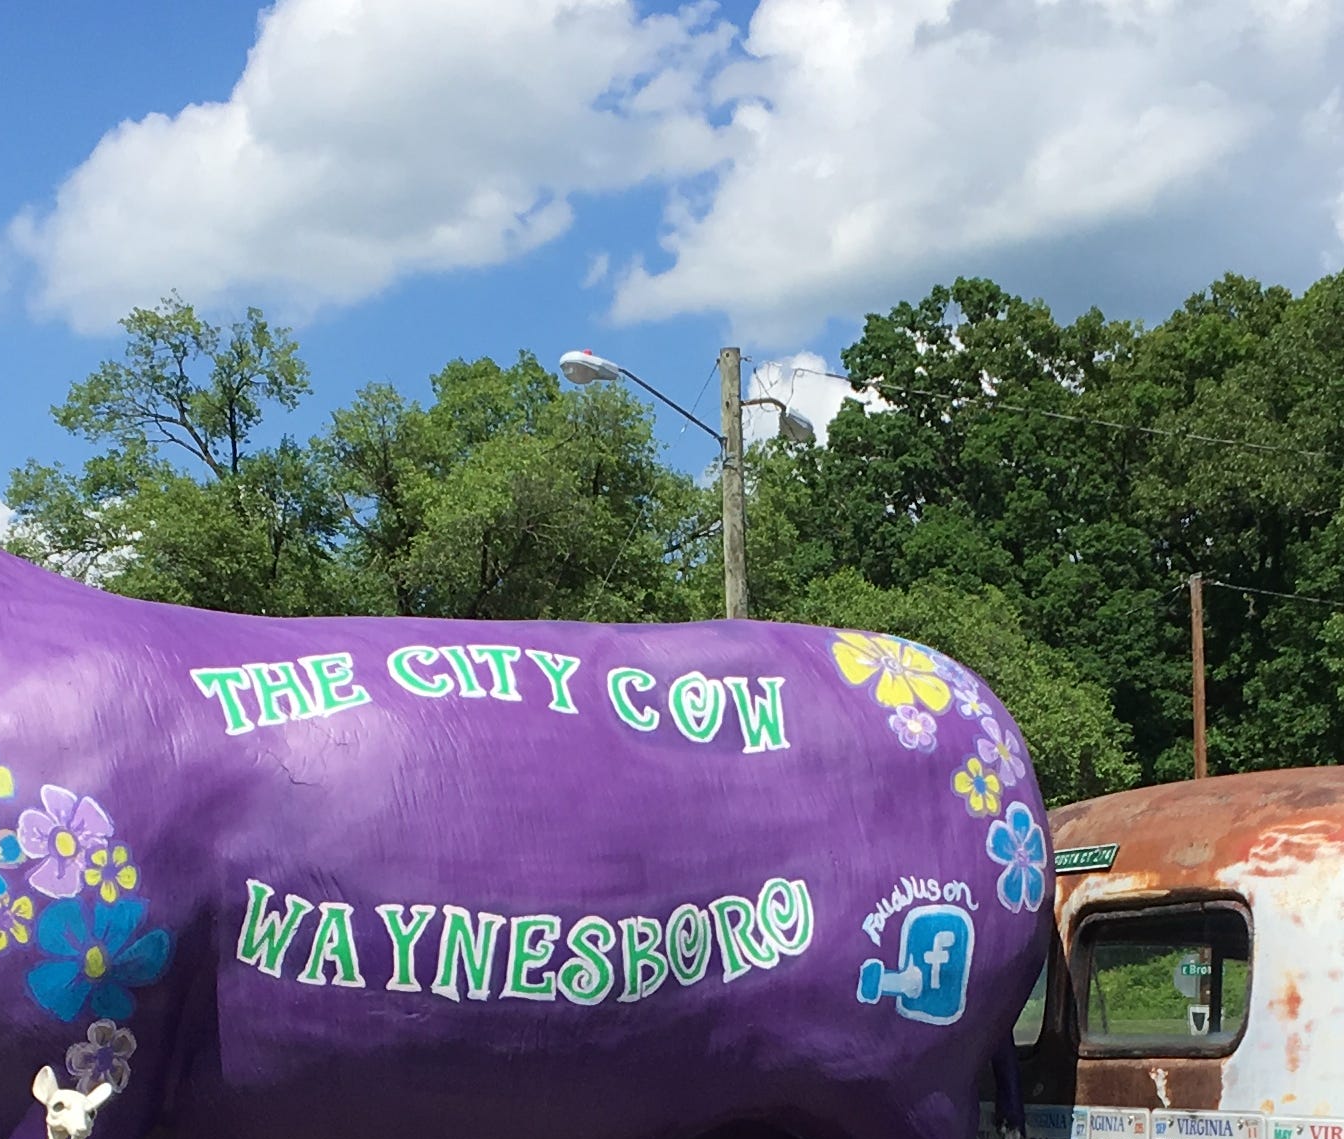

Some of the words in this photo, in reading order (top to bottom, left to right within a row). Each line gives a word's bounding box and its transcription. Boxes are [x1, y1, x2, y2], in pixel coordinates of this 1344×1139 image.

[190, 652, 373, 736] THE
[387, 645, 581, 714] CITY
[607, 667, 791, 754] COW
[910, 875, 942, 902] us
[943, 879, 979, 911] on
[236, 877, 815, 1005] WAYNESBORO
[1177, 1118, 1233, 1137] VIRGINIA
